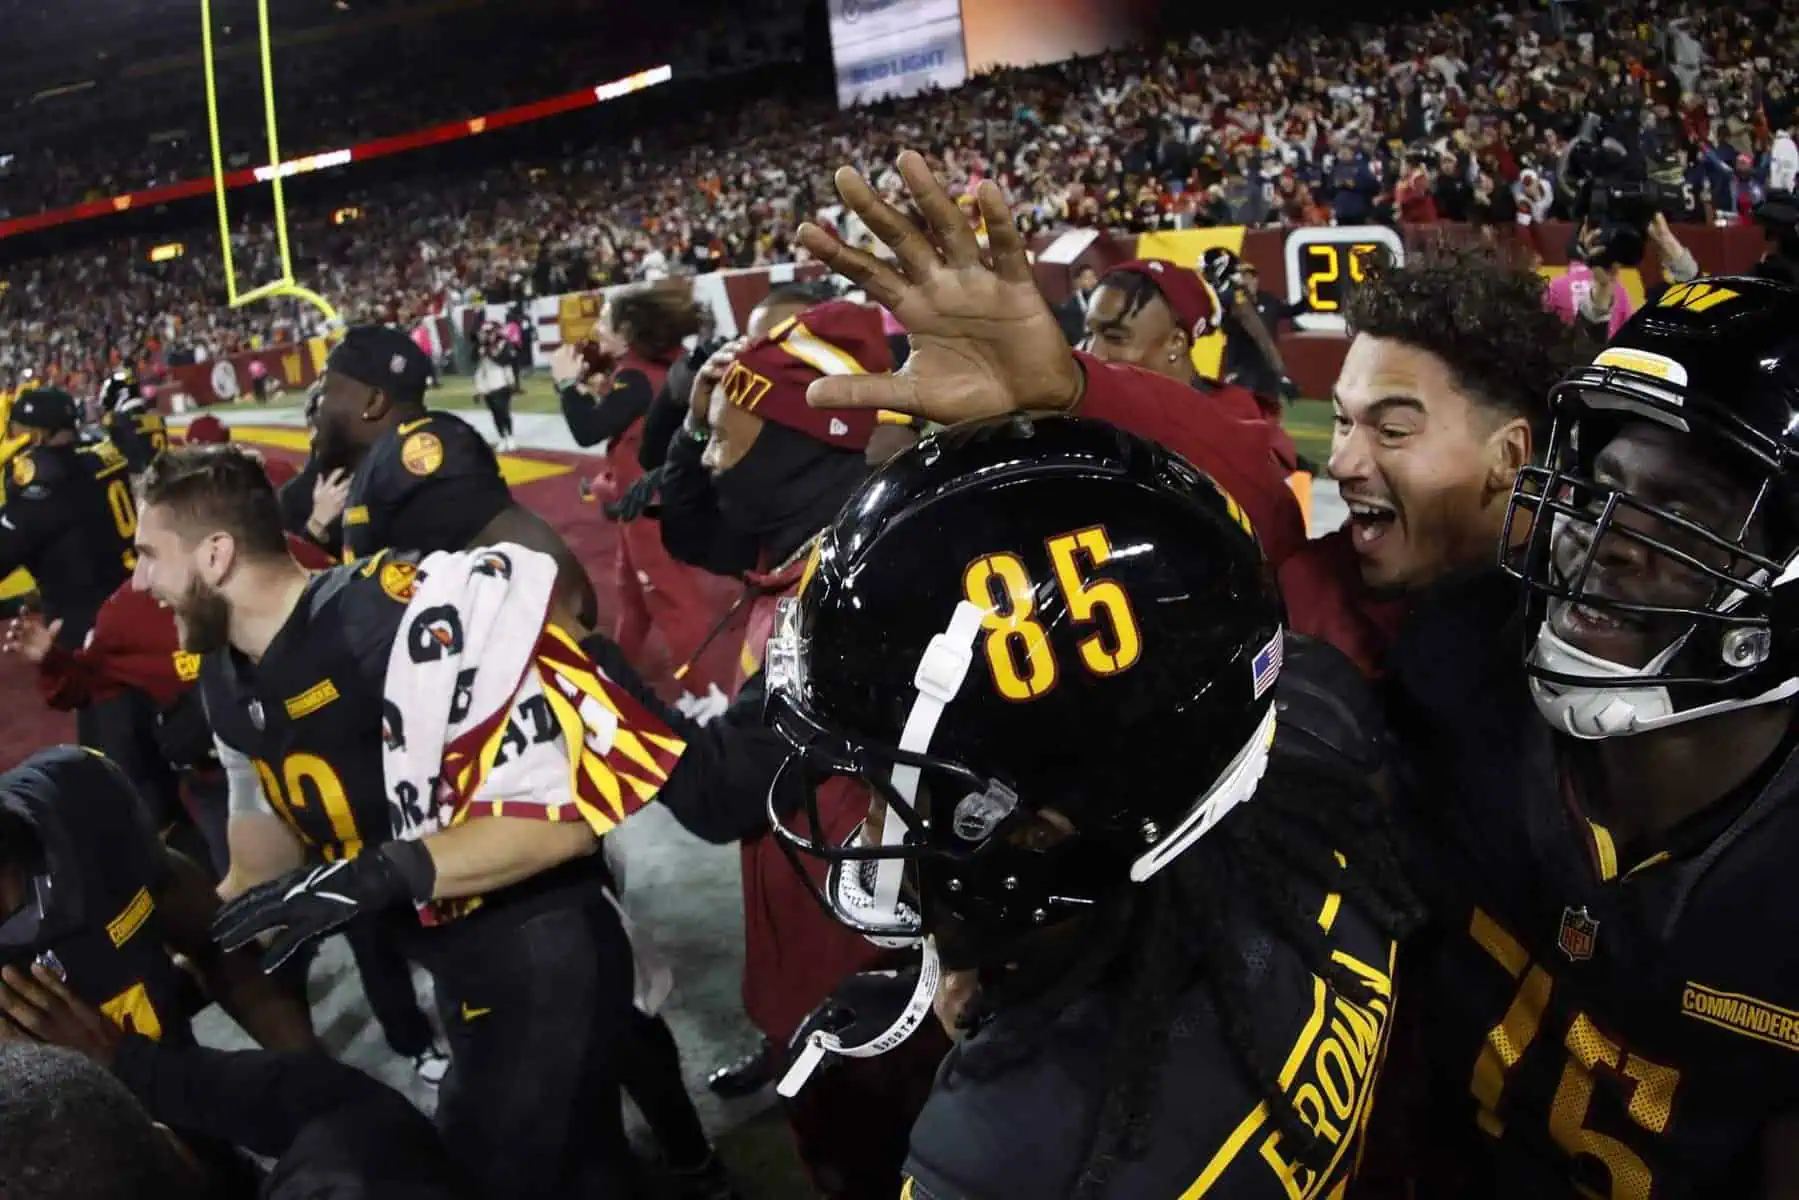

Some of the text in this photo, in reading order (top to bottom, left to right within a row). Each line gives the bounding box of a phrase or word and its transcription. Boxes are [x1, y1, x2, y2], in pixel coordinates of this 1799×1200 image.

[961, 523, 1144, 704] 85
[1469, 904, 1681, 1199] 75
[1683, 988, 1799, 1045] COMMANDERS
